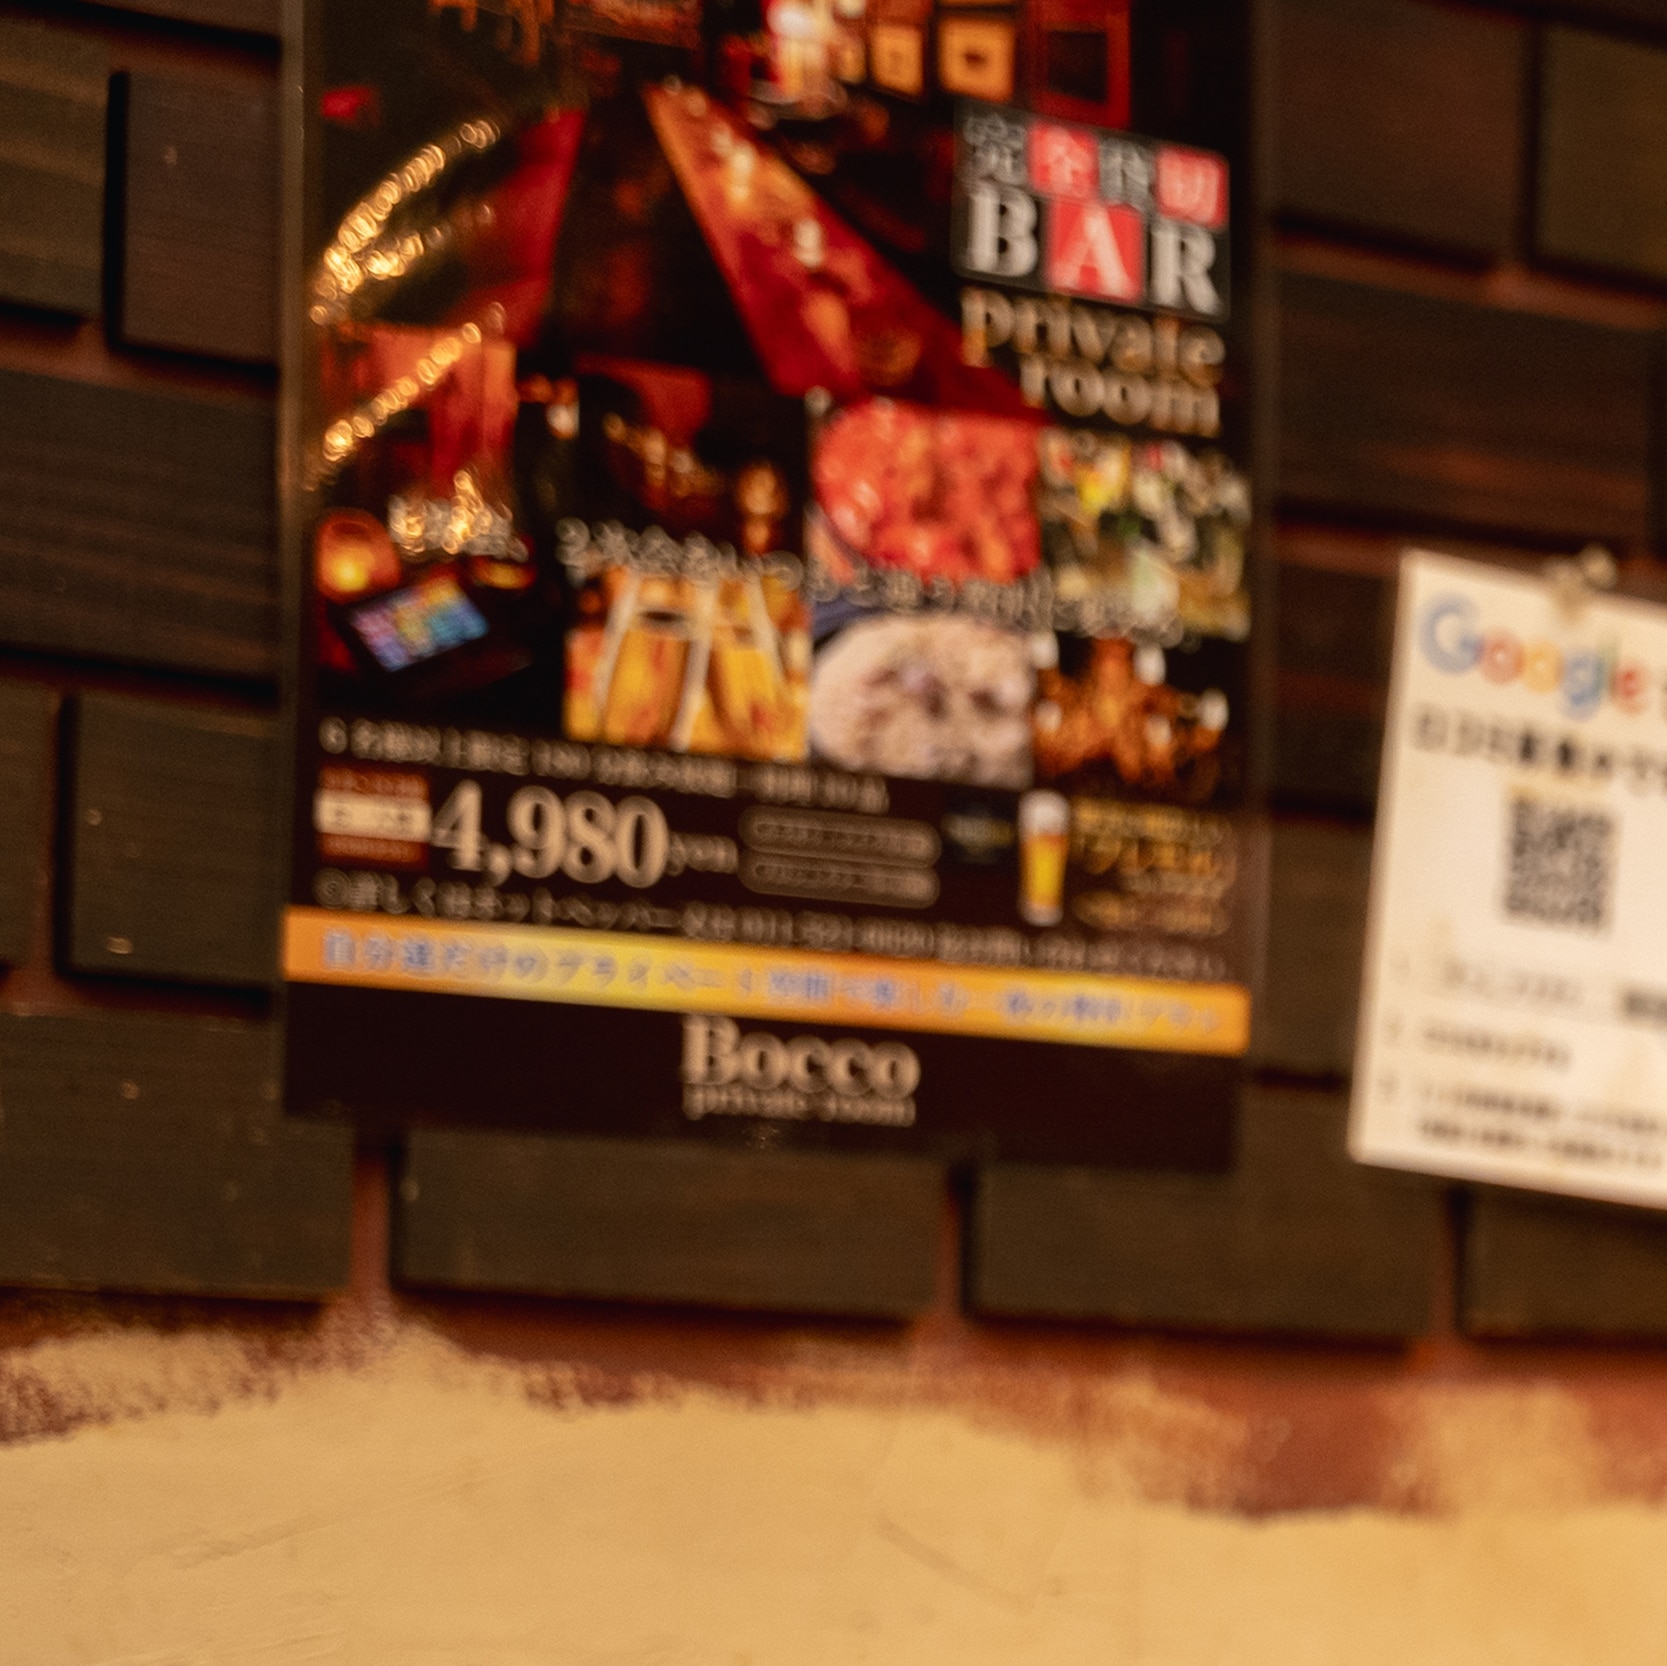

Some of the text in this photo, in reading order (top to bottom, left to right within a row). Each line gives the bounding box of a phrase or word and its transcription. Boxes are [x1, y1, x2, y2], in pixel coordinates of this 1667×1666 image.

[966, 183, 1223, 314] BAR
[961, 287, 1226, 386] private
[1019, 353, 1221, 437] room
[1418, 590, 1650, 720] Google
[430, 779, 671, 889] 4,980
[682, 1013, 921, 1100] Bocco
